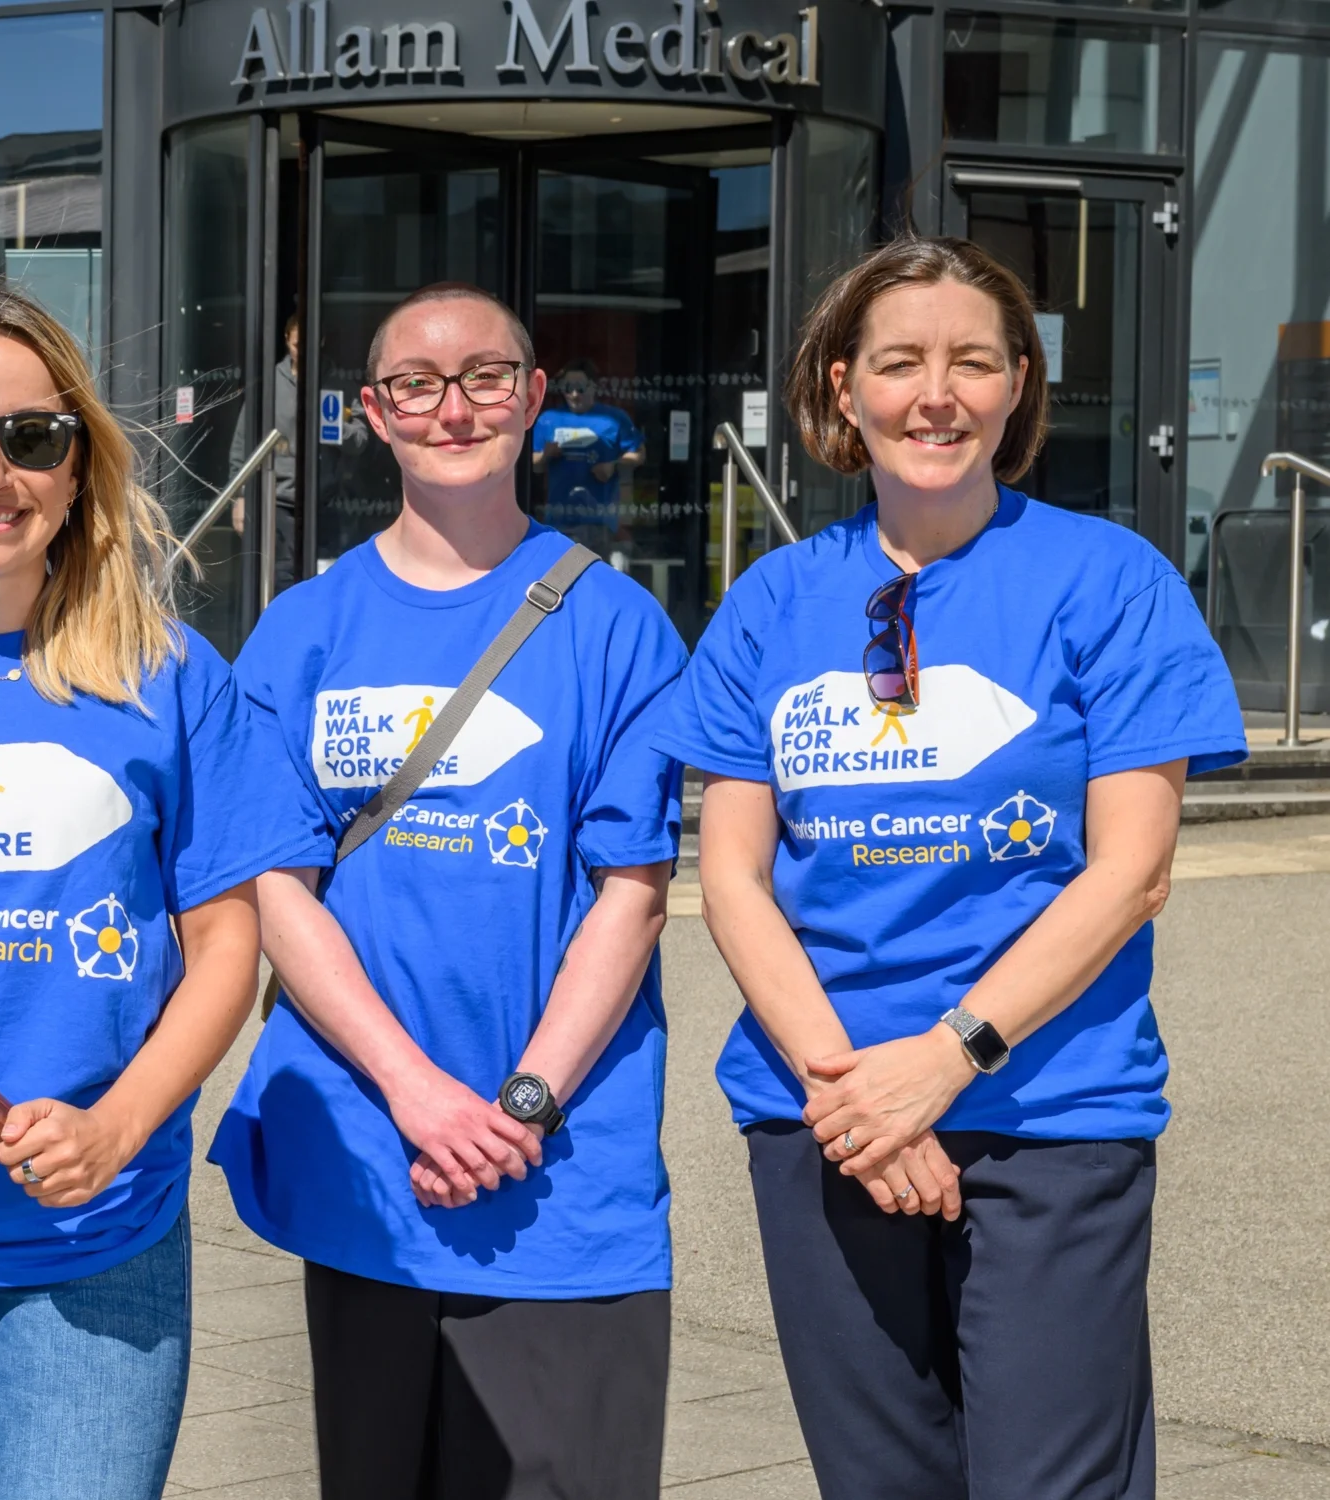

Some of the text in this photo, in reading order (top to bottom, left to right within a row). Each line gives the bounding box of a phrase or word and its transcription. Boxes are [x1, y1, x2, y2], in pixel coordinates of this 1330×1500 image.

[230, 0, 820, 86] Allam Medical
[327, 697, 362, 717] WE
[792, 684, 825, 709] WE
[325, 714, 394, 737] WALK
[784, 706, 860, 729] WALK
[324, 736, 371, 758] FOR
[781, 729, 832, 754] FOR
[326, 755, 458, 779] YORKSRE
[780, 747, 938, 778] YORKSHIRE
[404, 804, 480, 829] Cancer
[787, 813, 972, 840] Yorkshire Cancer
[384, 826, 473, 853] Research
[852, 840, 970, 866] Research
